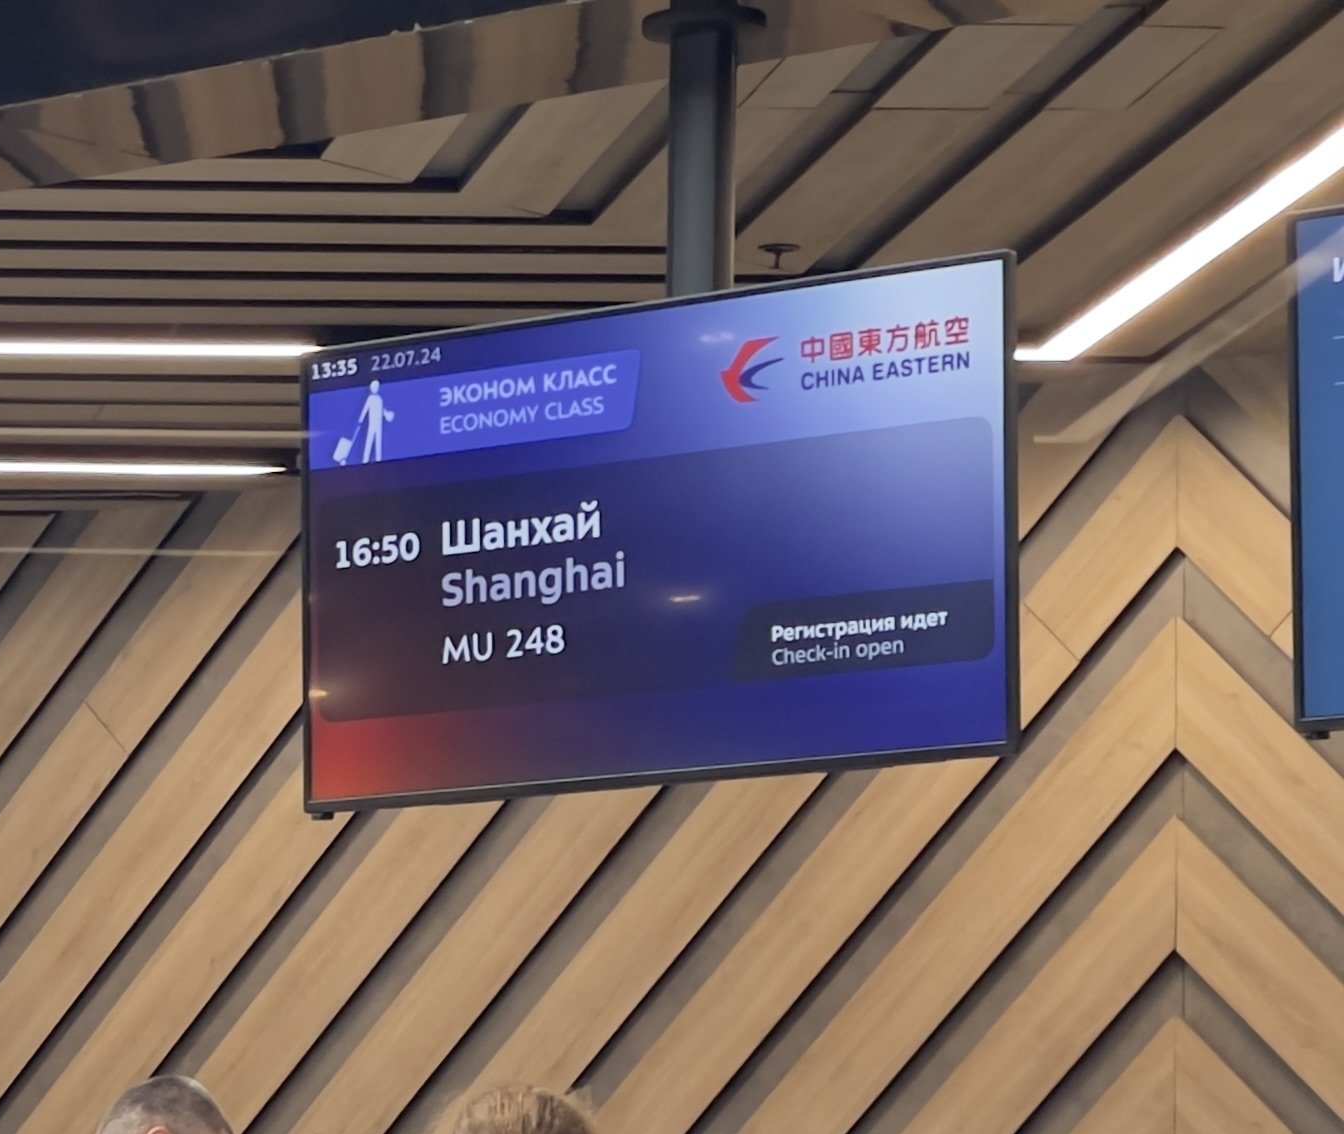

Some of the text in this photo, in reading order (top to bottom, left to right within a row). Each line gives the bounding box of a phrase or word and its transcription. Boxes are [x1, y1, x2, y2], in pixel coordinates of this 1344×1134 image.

[800, 316, 970, 364] 中國東方航空
[311, 346, 442, 380] 13:35 22.07.24
[801, 351, 971, 391] CHINA EASTERN
[439, 364, 618, 406] ЭКОНОМ КЛАСС
[440, 396, 605, 435] ECONOMY CLASS
[441, 500, 602, 555] Шанхай
[334, 530, 421, 570] 16:50
[442, 551, 626, 608] Shanghai
[442, 624, 565, 665] MU 248
[771, 608, 948, 644] Регистрация идет
[772, 636, 904, 666] Check-in open
